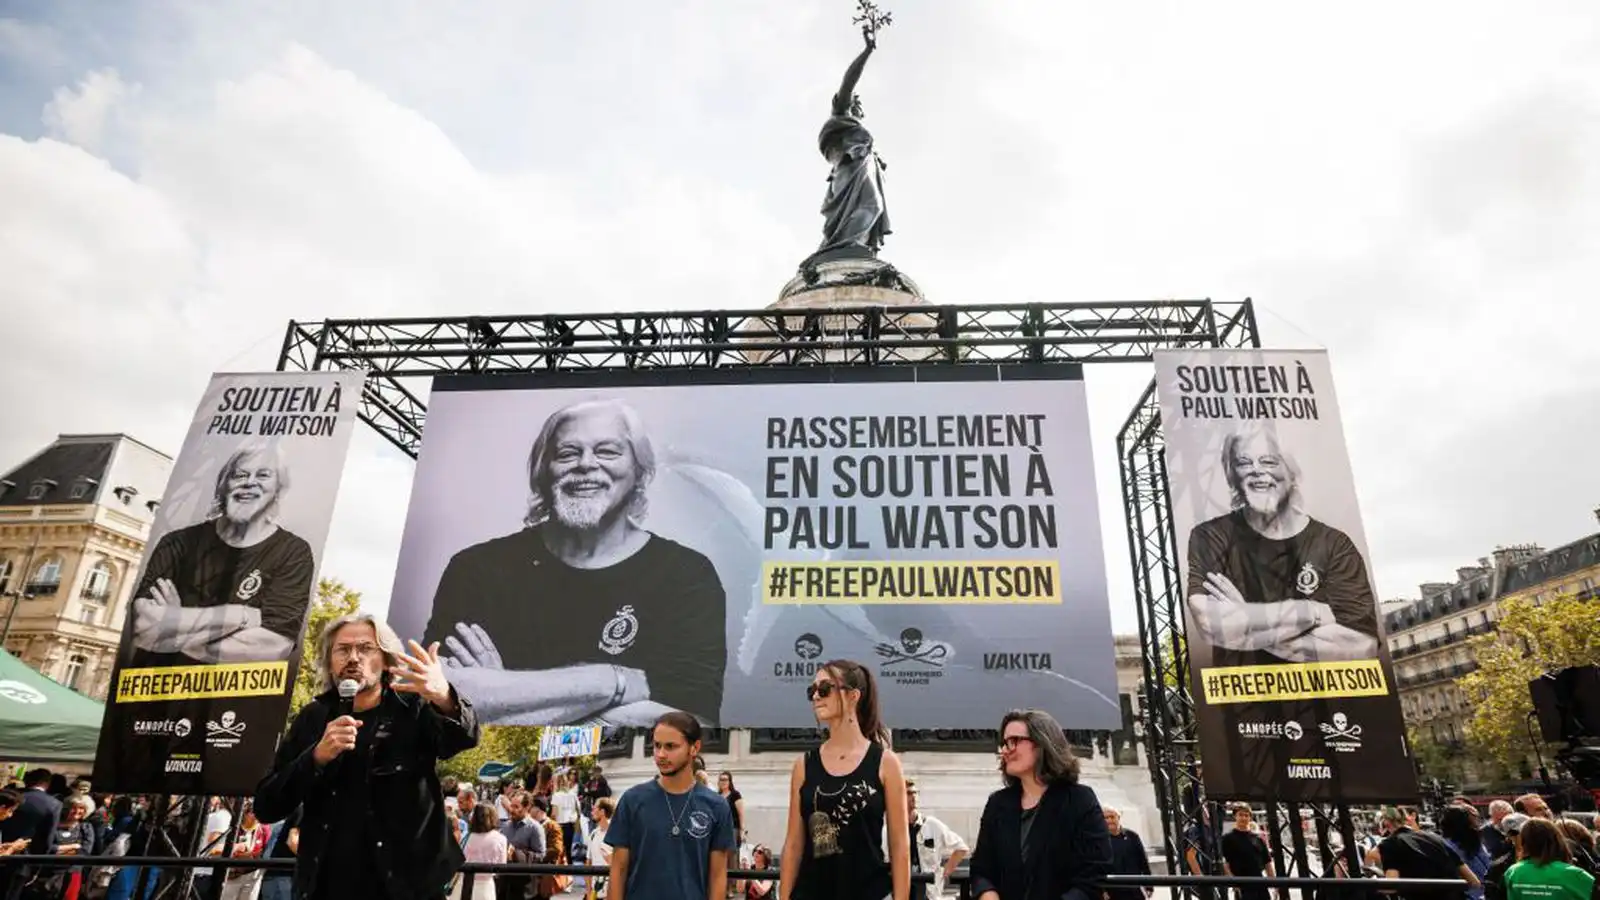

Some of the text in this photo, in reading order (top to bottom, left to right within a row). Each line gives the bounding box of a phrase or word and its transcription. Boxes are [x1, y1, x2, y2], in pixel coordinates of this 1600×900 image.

[1176, 360, 1315, 394] SOUTIEN À
[218, 381, 342, 413] SOUTIEN À
[1181, 396, 1319, 420] PAUL WATSON
[207, 415, 337, 437] PAUL WATSON
[766, 414, 1046, 449] RASSEMBLEMENT
[765, 445, 1054, 498] EN SOUTIEN À
[764, 504, 1058, 550] PAUL WATSON
[769, 566, 1054, 598] #FREEPAULWATSON
[983, 652, 1052, 670] VAKITA
[120, 668, 283, 697] #FREEPAULWATSON
[1208, 667, 1383, 697] #FREEPAULWATSON
[1287, 765, 1332, 779] VAKITA
